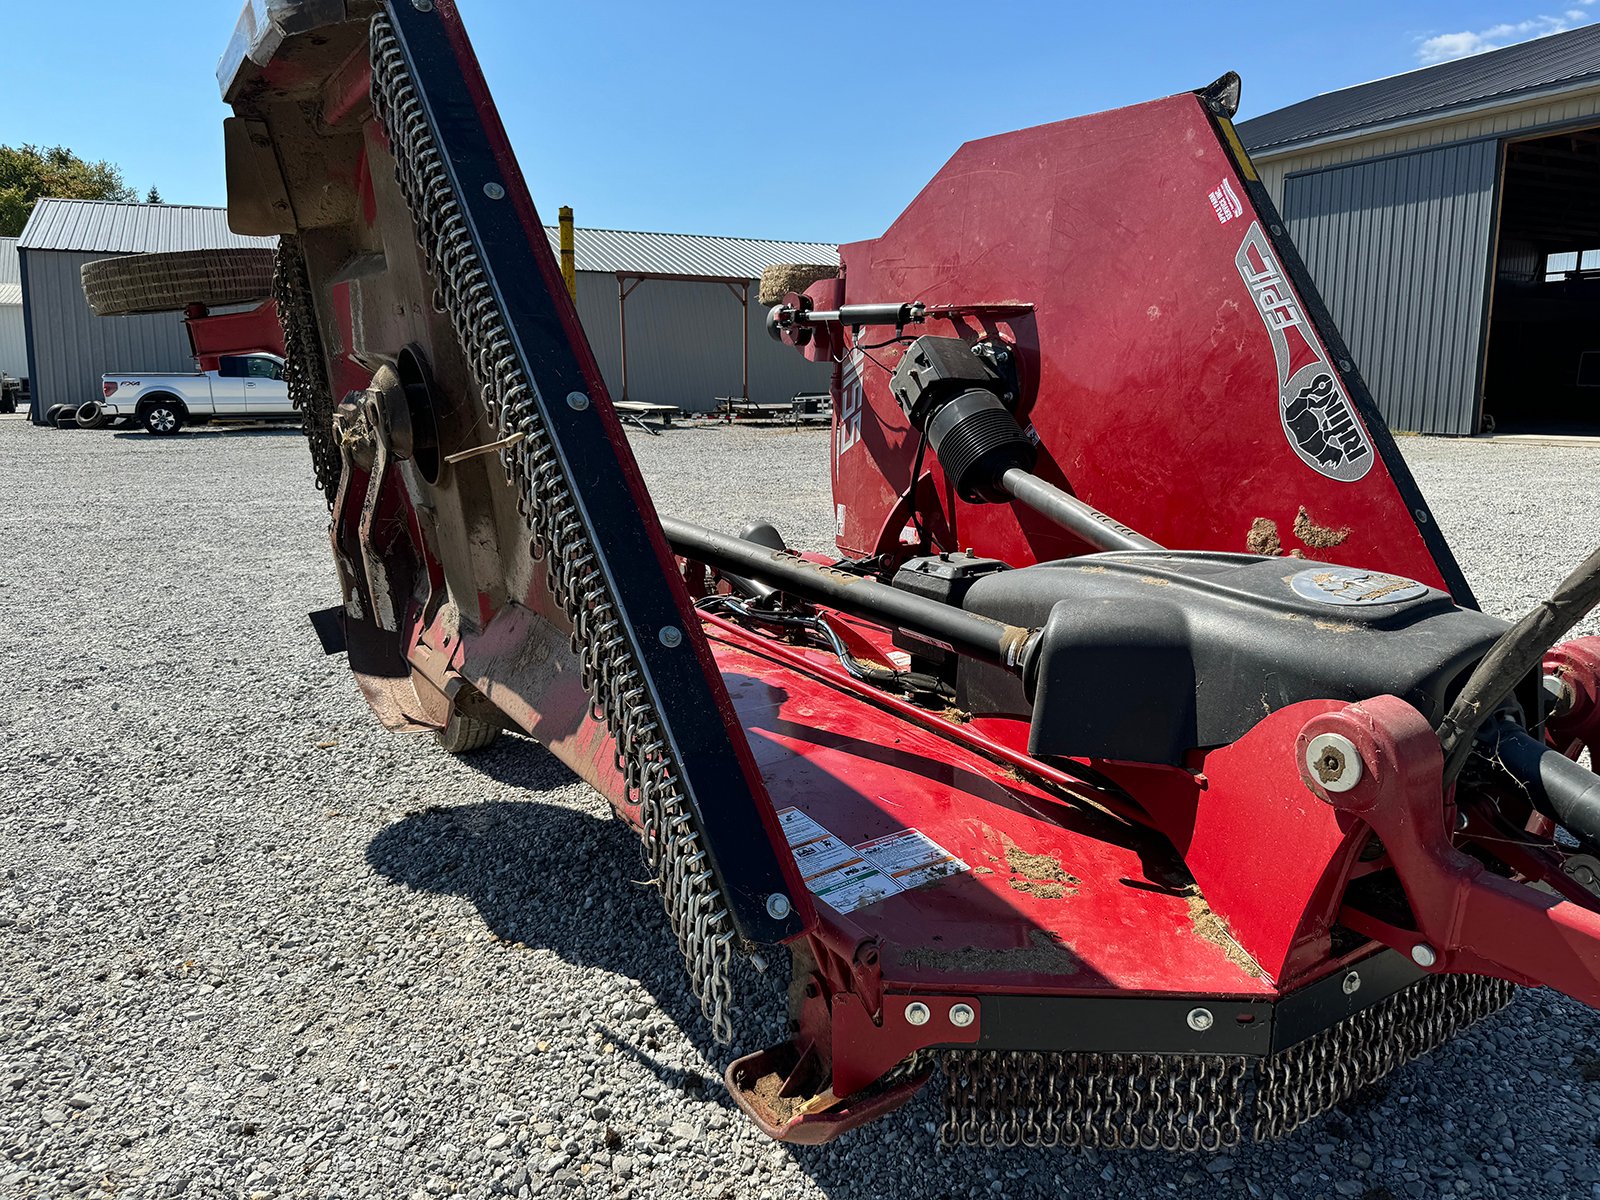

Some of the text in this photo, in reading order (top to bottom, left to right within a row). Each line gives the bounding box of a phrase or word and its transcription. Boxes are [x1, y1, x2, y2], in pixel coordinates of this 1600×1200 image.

[1208, 191, 1220, 209] FARM
[1219, 197, 1233, 221] SERVICE
[1214, 206, 1228, 224] APPLE
[1243, 254, 1302, 331] EPIC
[1309, 373, 1370, 464] RHINO
